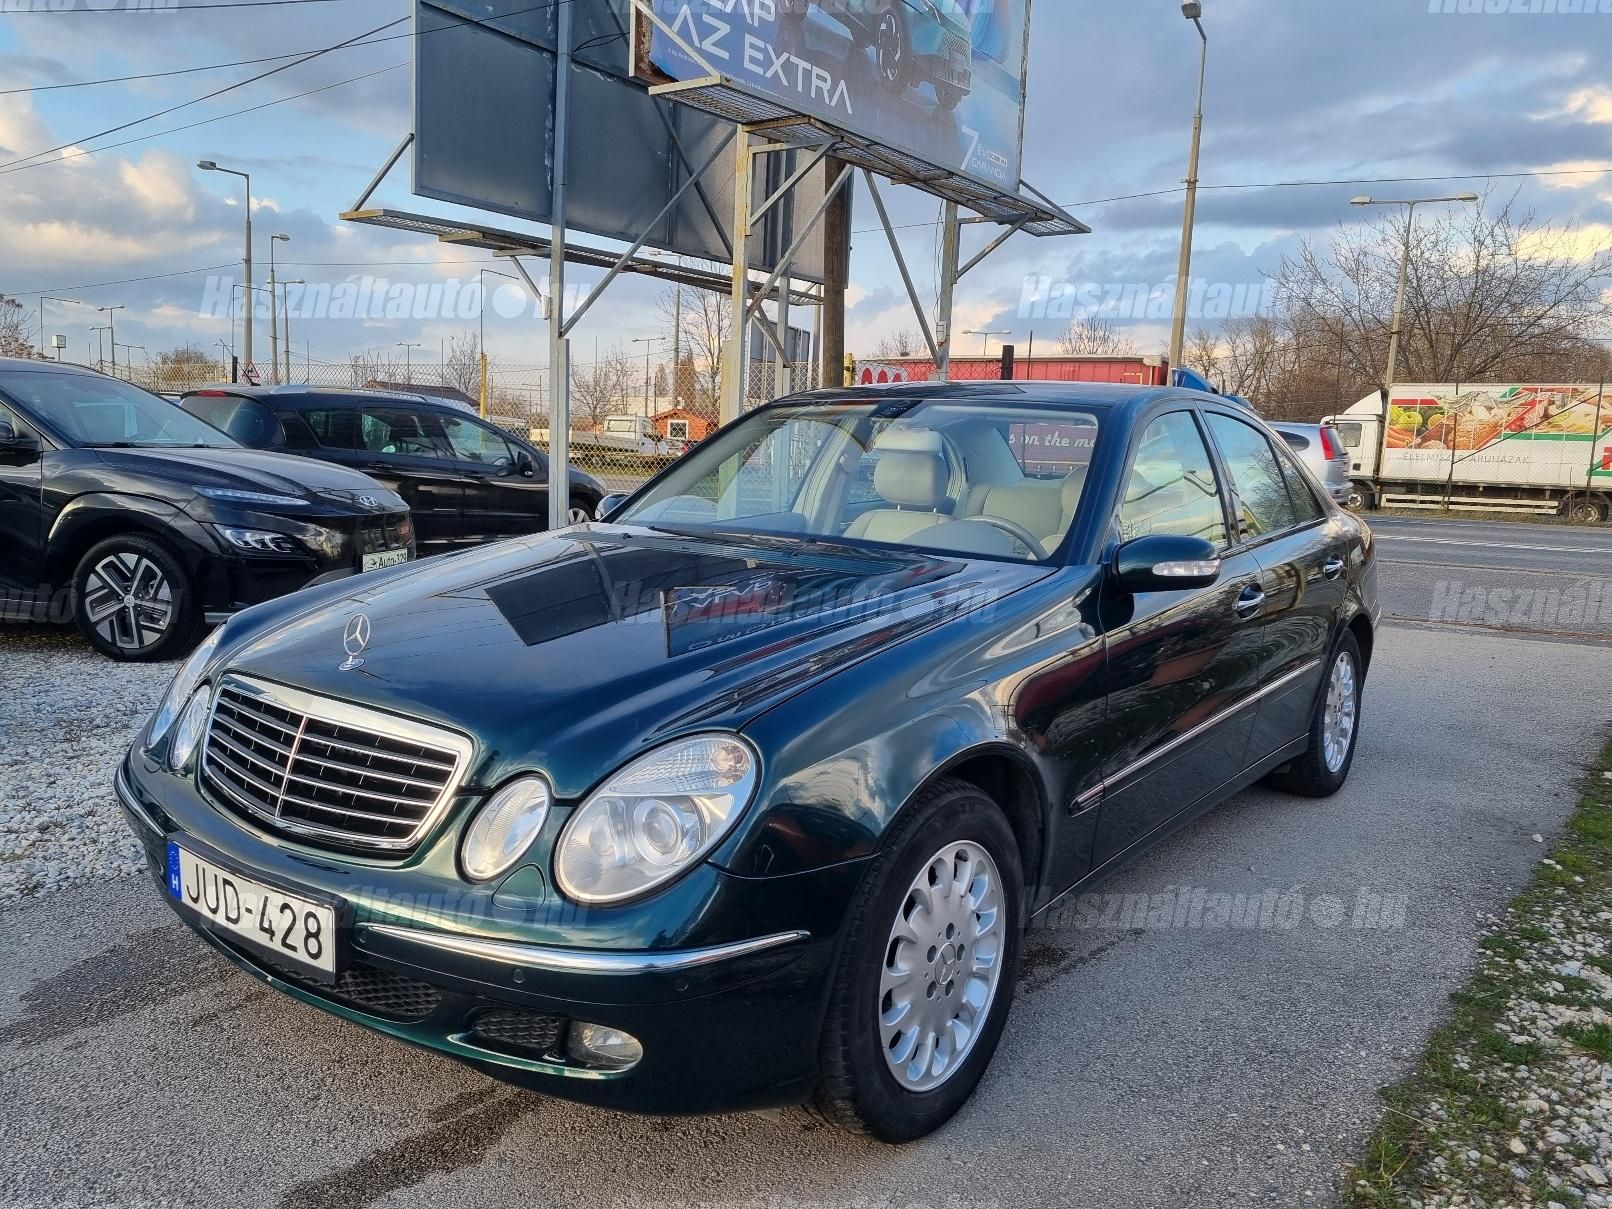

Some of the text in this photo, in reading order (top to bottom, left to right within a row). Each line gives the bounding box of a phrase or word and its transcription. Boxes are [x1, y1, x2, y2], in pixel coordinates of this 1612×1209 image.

[671, 4, 731, 60] AZ
[743, 33, 853, 115] EXTRA
[960, 125, 979, 170] 7
[1044, 430, 1070, 447] the
[186, 863, 323, 961] JUD-428
